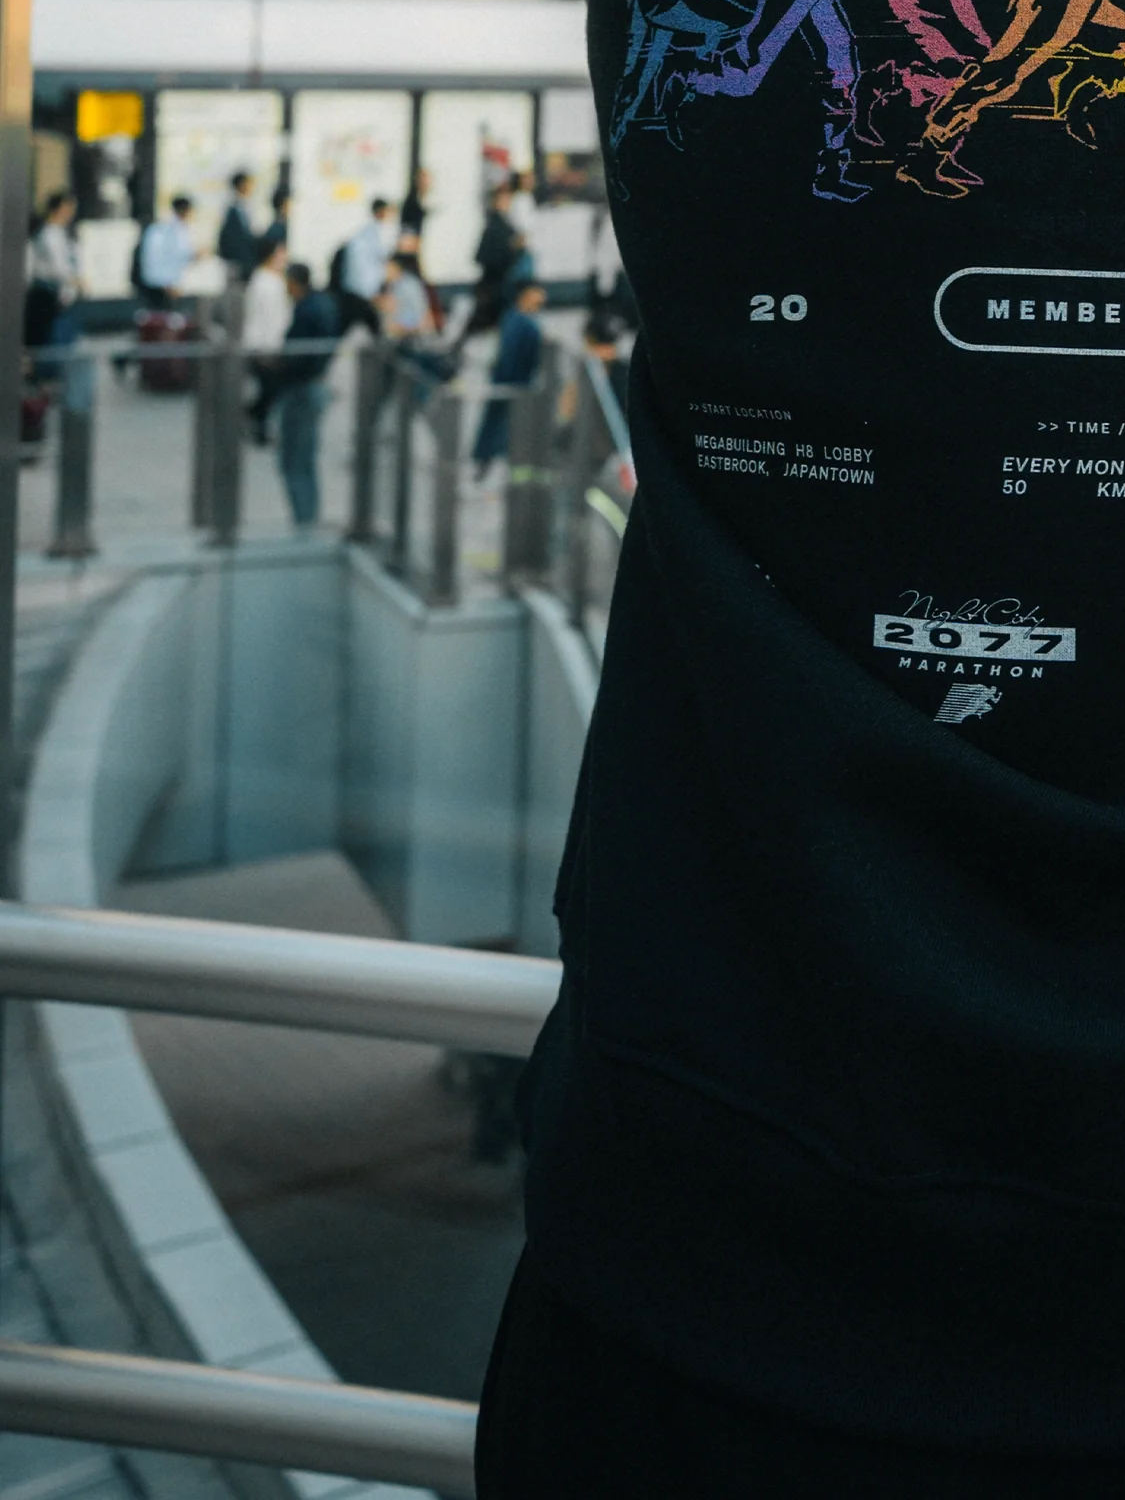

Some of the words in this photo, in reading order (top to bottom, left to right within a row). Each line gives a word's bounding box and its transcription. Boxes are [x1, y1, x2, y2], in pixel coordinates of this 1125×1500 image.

[749, 294, 808, 322] 20
[701, 403, 732, 416] START
[734, 407, 793, 422] LOCATION
[1066, 421, 1111, 435] TIME
[694, 434, 786, 457] MEGABUILDING
[795, 443, 815, 459] H8
[823, 445, 874, 464] LOBBY
[697, 453, 770, 477] EASTBROOK,
[782, 461, 875, 485] JAPANTOWN
[1002, 456, 1071, 475] EVERY
[1002, 479, 1028, 495] 50
[898, 589, 987, 632] Night
[983, 597, 1046, 639] City
[883, 620, 1064, 656] 2077
[898, 656, 1044, 678] MARATHON
